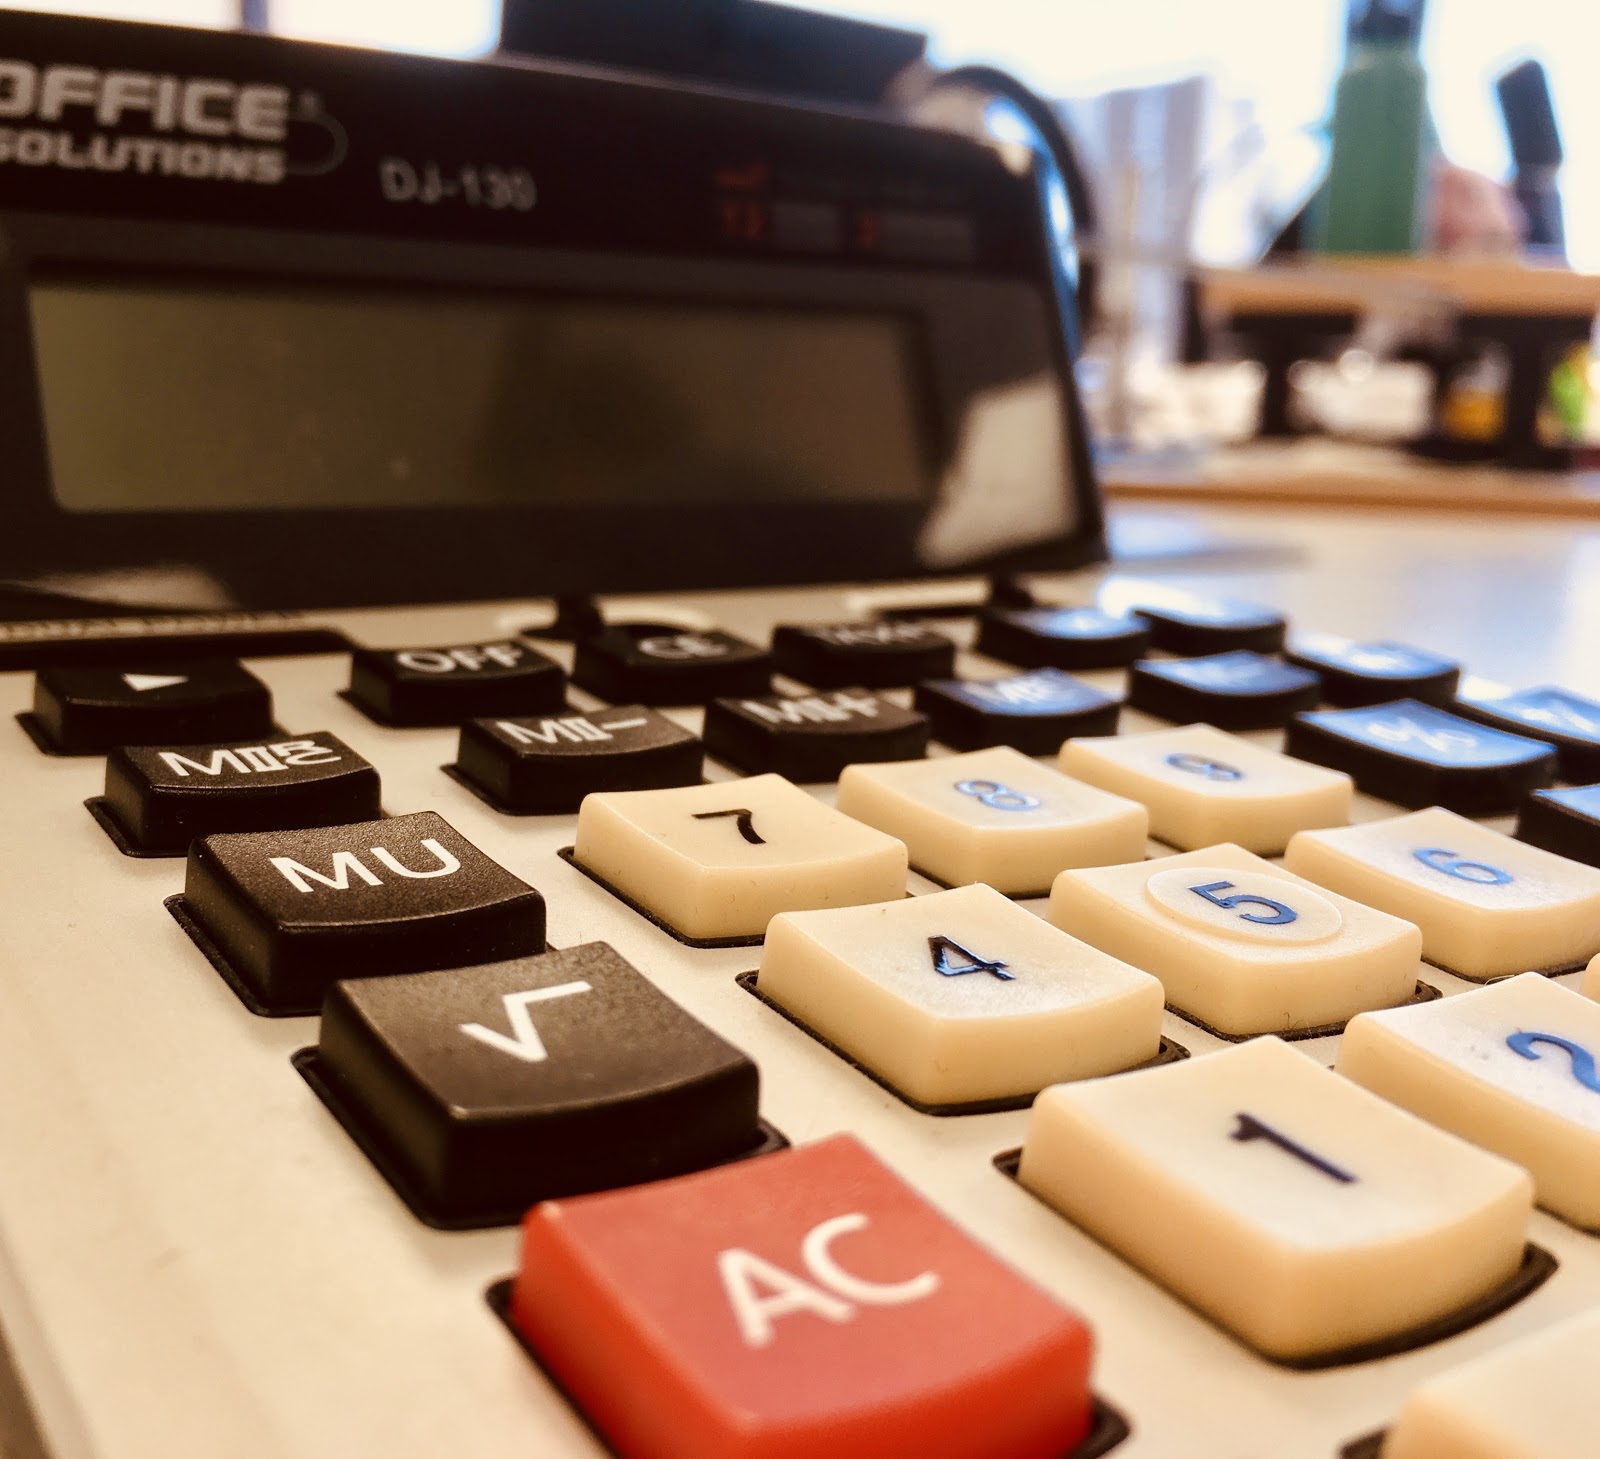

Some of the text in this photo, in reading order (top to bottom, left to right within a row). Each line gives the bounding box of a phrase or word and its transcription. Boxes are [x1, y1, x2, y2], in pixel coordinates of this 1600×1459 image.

[397, 644, 523, 673] OFF
[954, 779, 1041, 811] 8
[692, 808, 767, 845] 7
[269, 838, 461, 894] MU
[1414, 848, 1514, 886] 6
[1188, 881, 1298, 926] 5
[928, 935, 1017, 981] 4
[1507, 1032, 1600, 1096] 2
[1227, 1112, 1357, 1186] 1
[717, 1213, 940, 1350] AC
